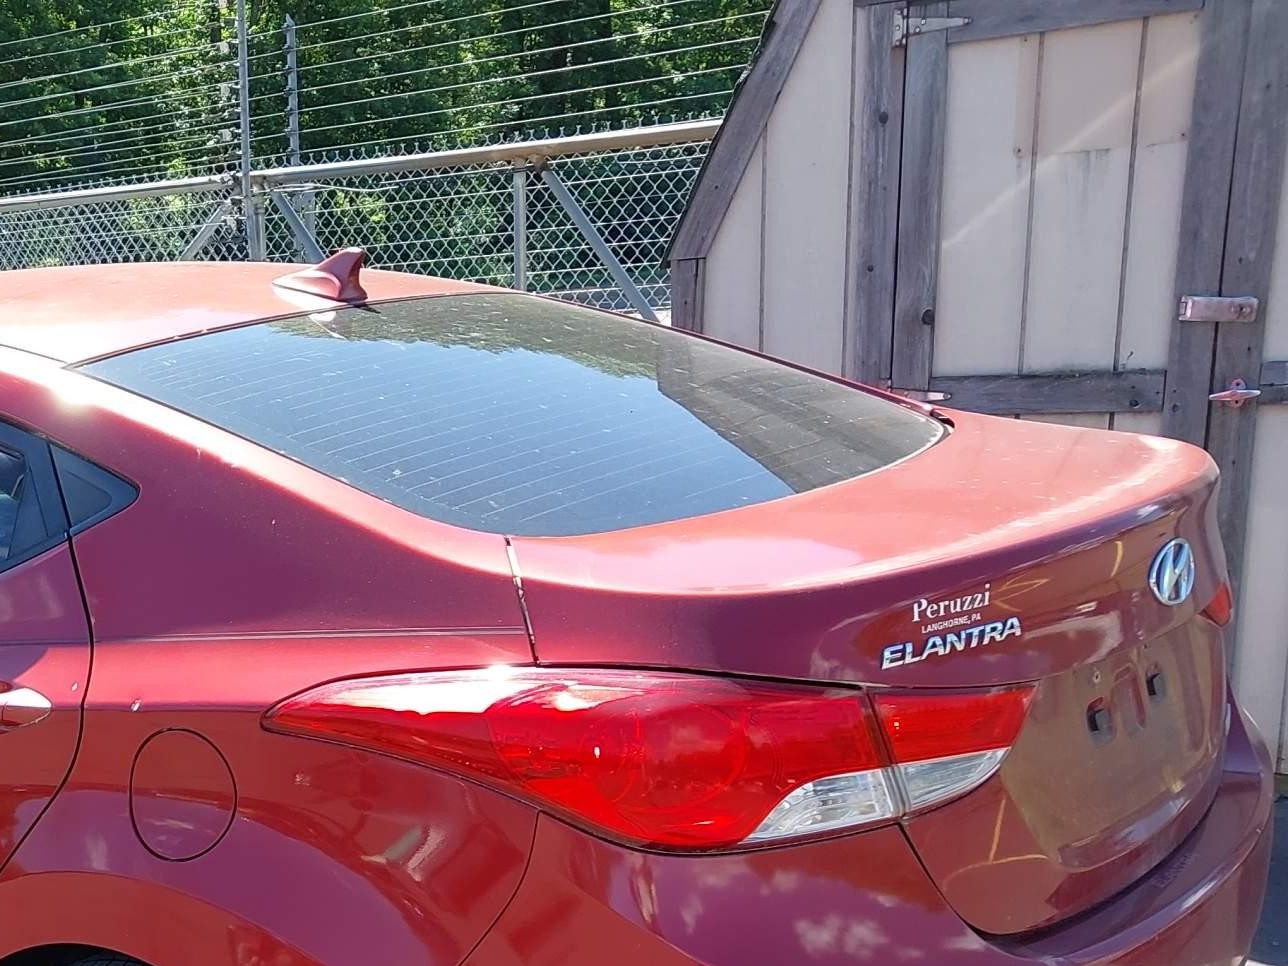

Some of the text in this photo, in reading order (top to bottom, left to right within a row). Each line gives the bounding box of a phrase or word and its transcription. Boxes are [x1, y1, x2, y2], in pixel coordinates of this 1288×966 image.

[912, 583, 990, 622] Peruzzi
[971, 613, 982, 622] PA
[881, 616, 1022, 670] ELANTRA
